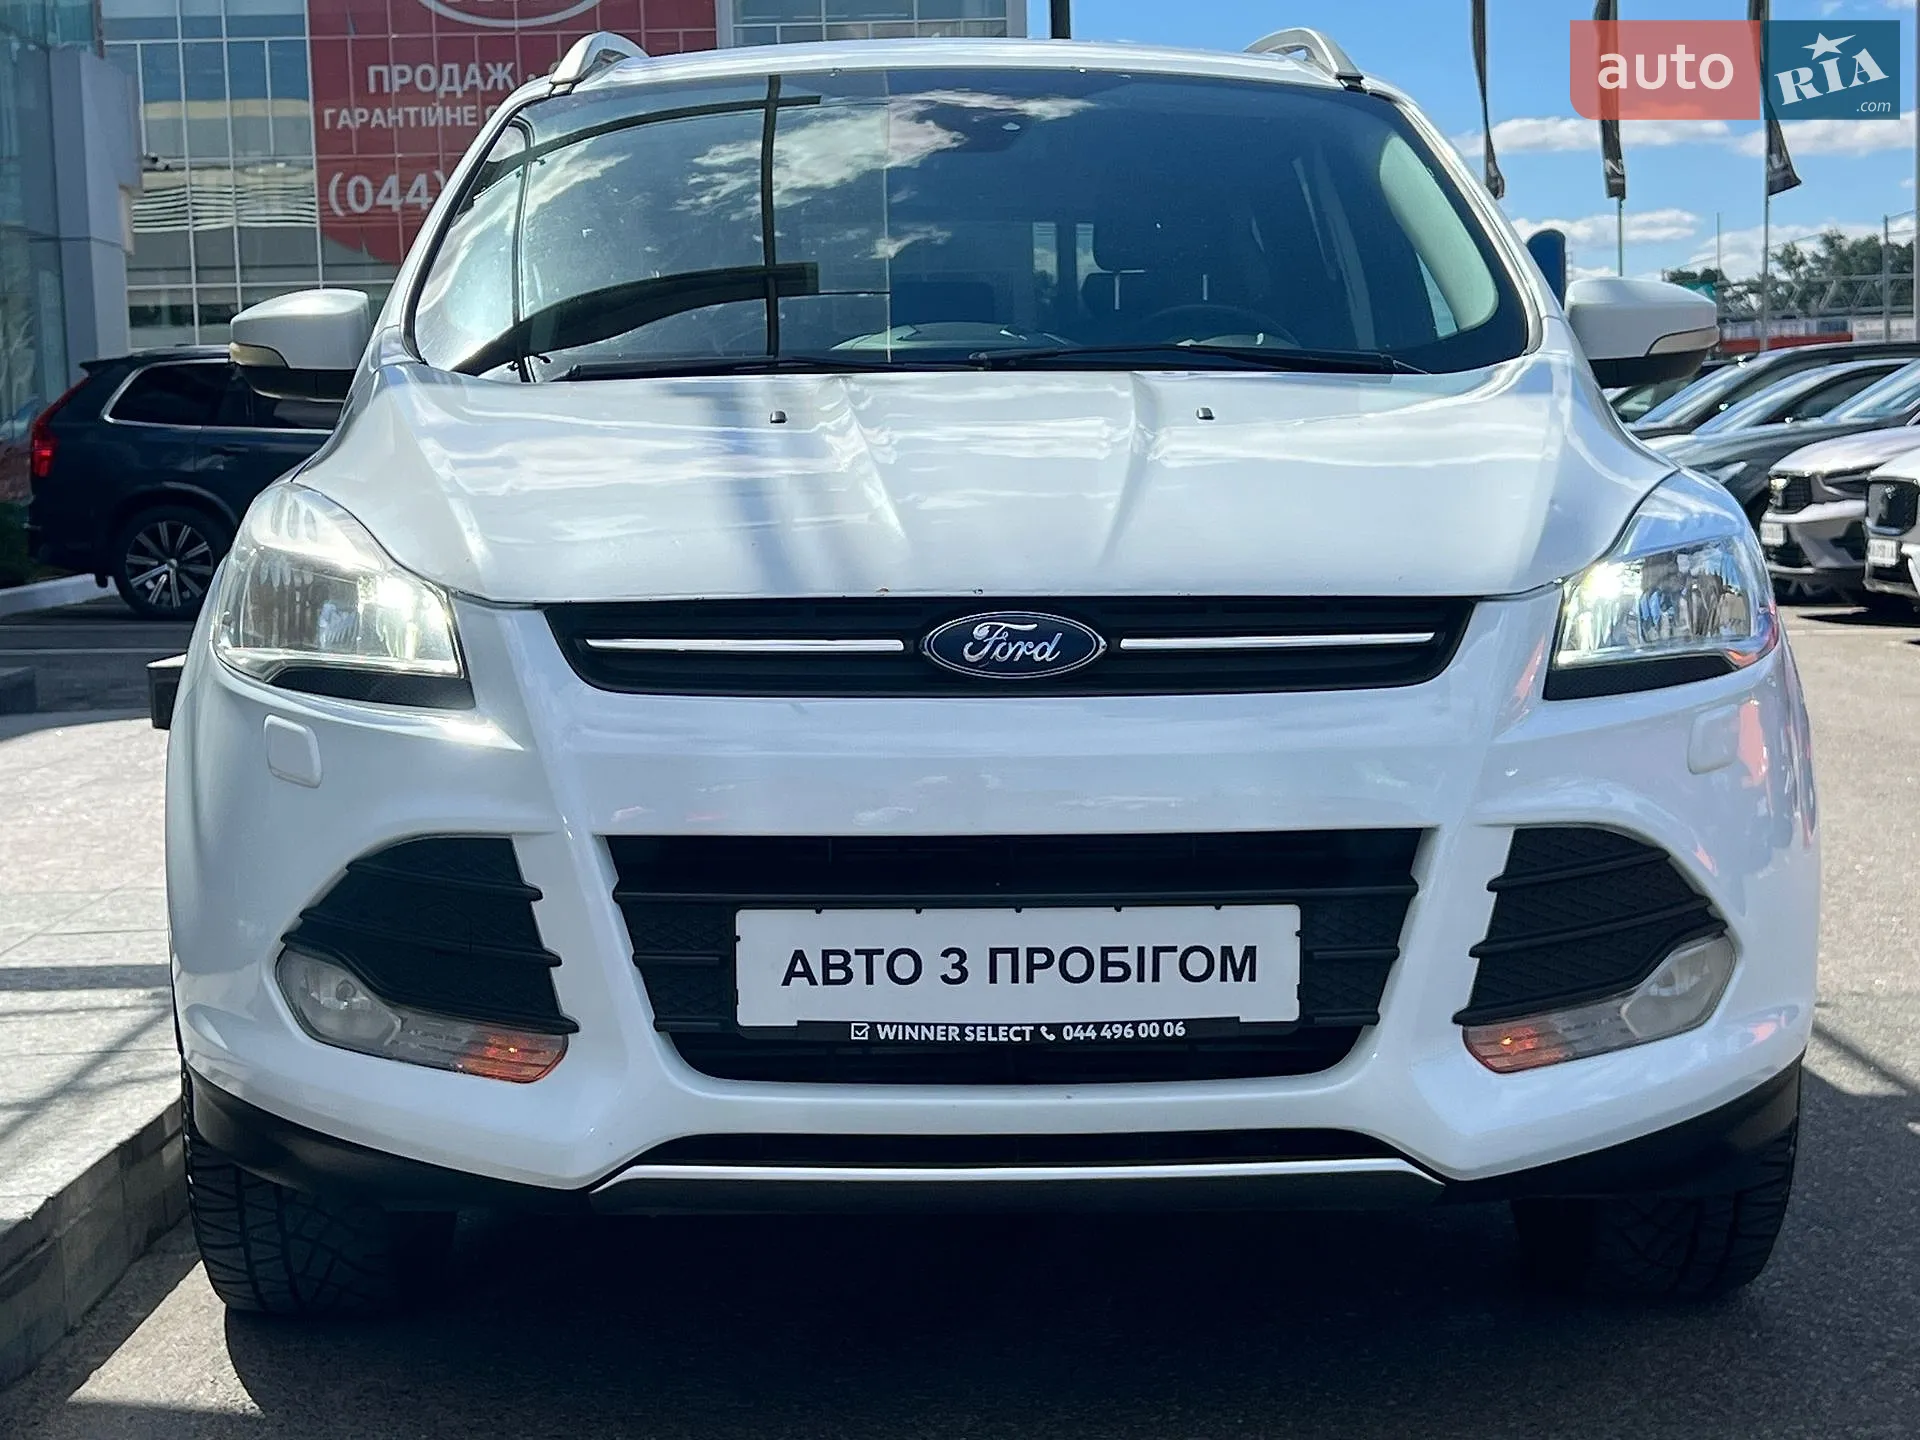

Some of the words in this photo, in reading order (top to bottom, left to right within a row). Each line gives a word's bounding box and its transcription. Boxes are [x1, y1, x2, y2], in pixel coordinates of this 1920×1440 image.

[367, 62, 516, 98] ПРОДАЖ
[323, 102, 477, 131] ГАРАНТІЙНЕ
[963, 621, 1063, 663] Ford
[781, 946, 923, 987] АВТО
[939, 946, 969, 986] З
[988, 944, 1258, 985] ПРОБІГОМ
[876, 1023, 961, 1042] WINNER
[964, 1024, 1034, 1042] SELECT
[1062, 1023, 1097, 1041] 044
[1099, 1022, 1133, 1040] 496
[1137, 1021, 1160, 1038] 00
[1163, 1020, 1186, 1038] 06
